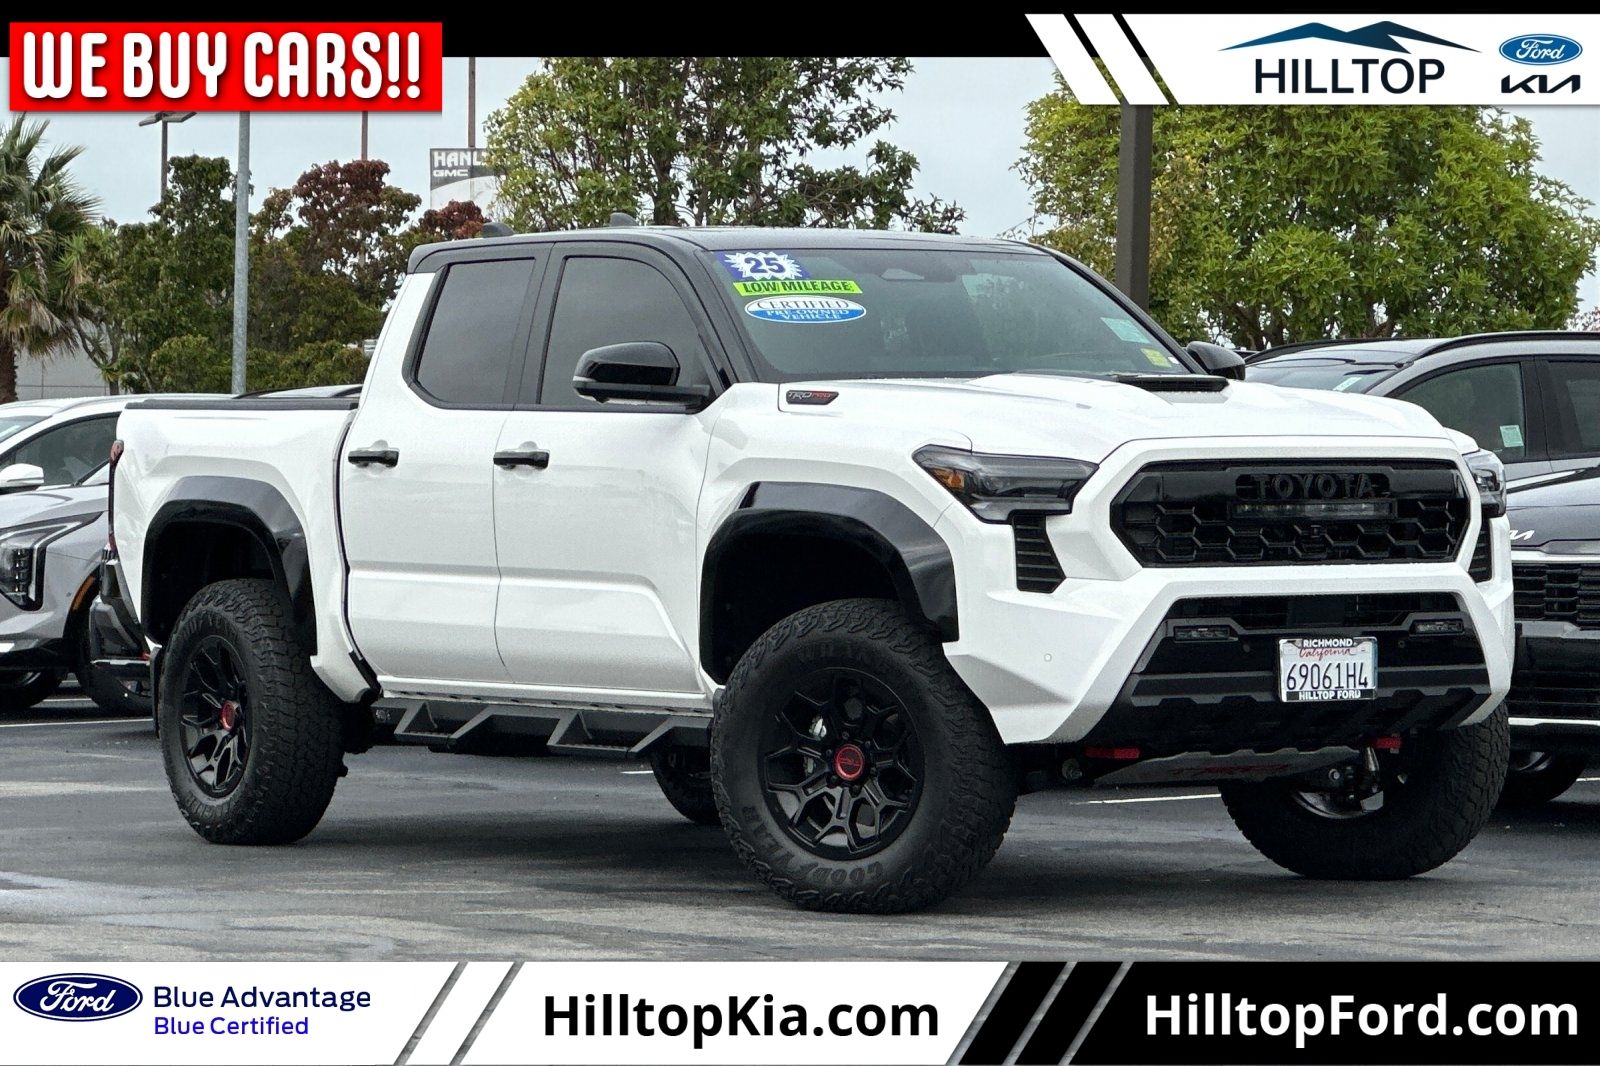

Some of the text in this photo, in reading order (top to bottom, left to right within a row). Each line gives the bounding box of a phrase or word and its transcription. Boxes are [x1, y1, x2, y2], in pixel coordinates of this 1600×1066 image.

[433, 169, 469, 177] GMC
[743, 257, 787, 274] 25
[743, 280, 854, 293] LOW MILEAGE
[757, 300, 849, 310] CERTIFIED
[1252, 473, 1375, 499] TOYOTA
[1303, 638, 1353, 648] RICHMOND
[1300, 647, 1353, 661] California
[1286, 662, 1368, 691] 69061H4
[1299, 690, 1361, 700] HILLTOP FORD
